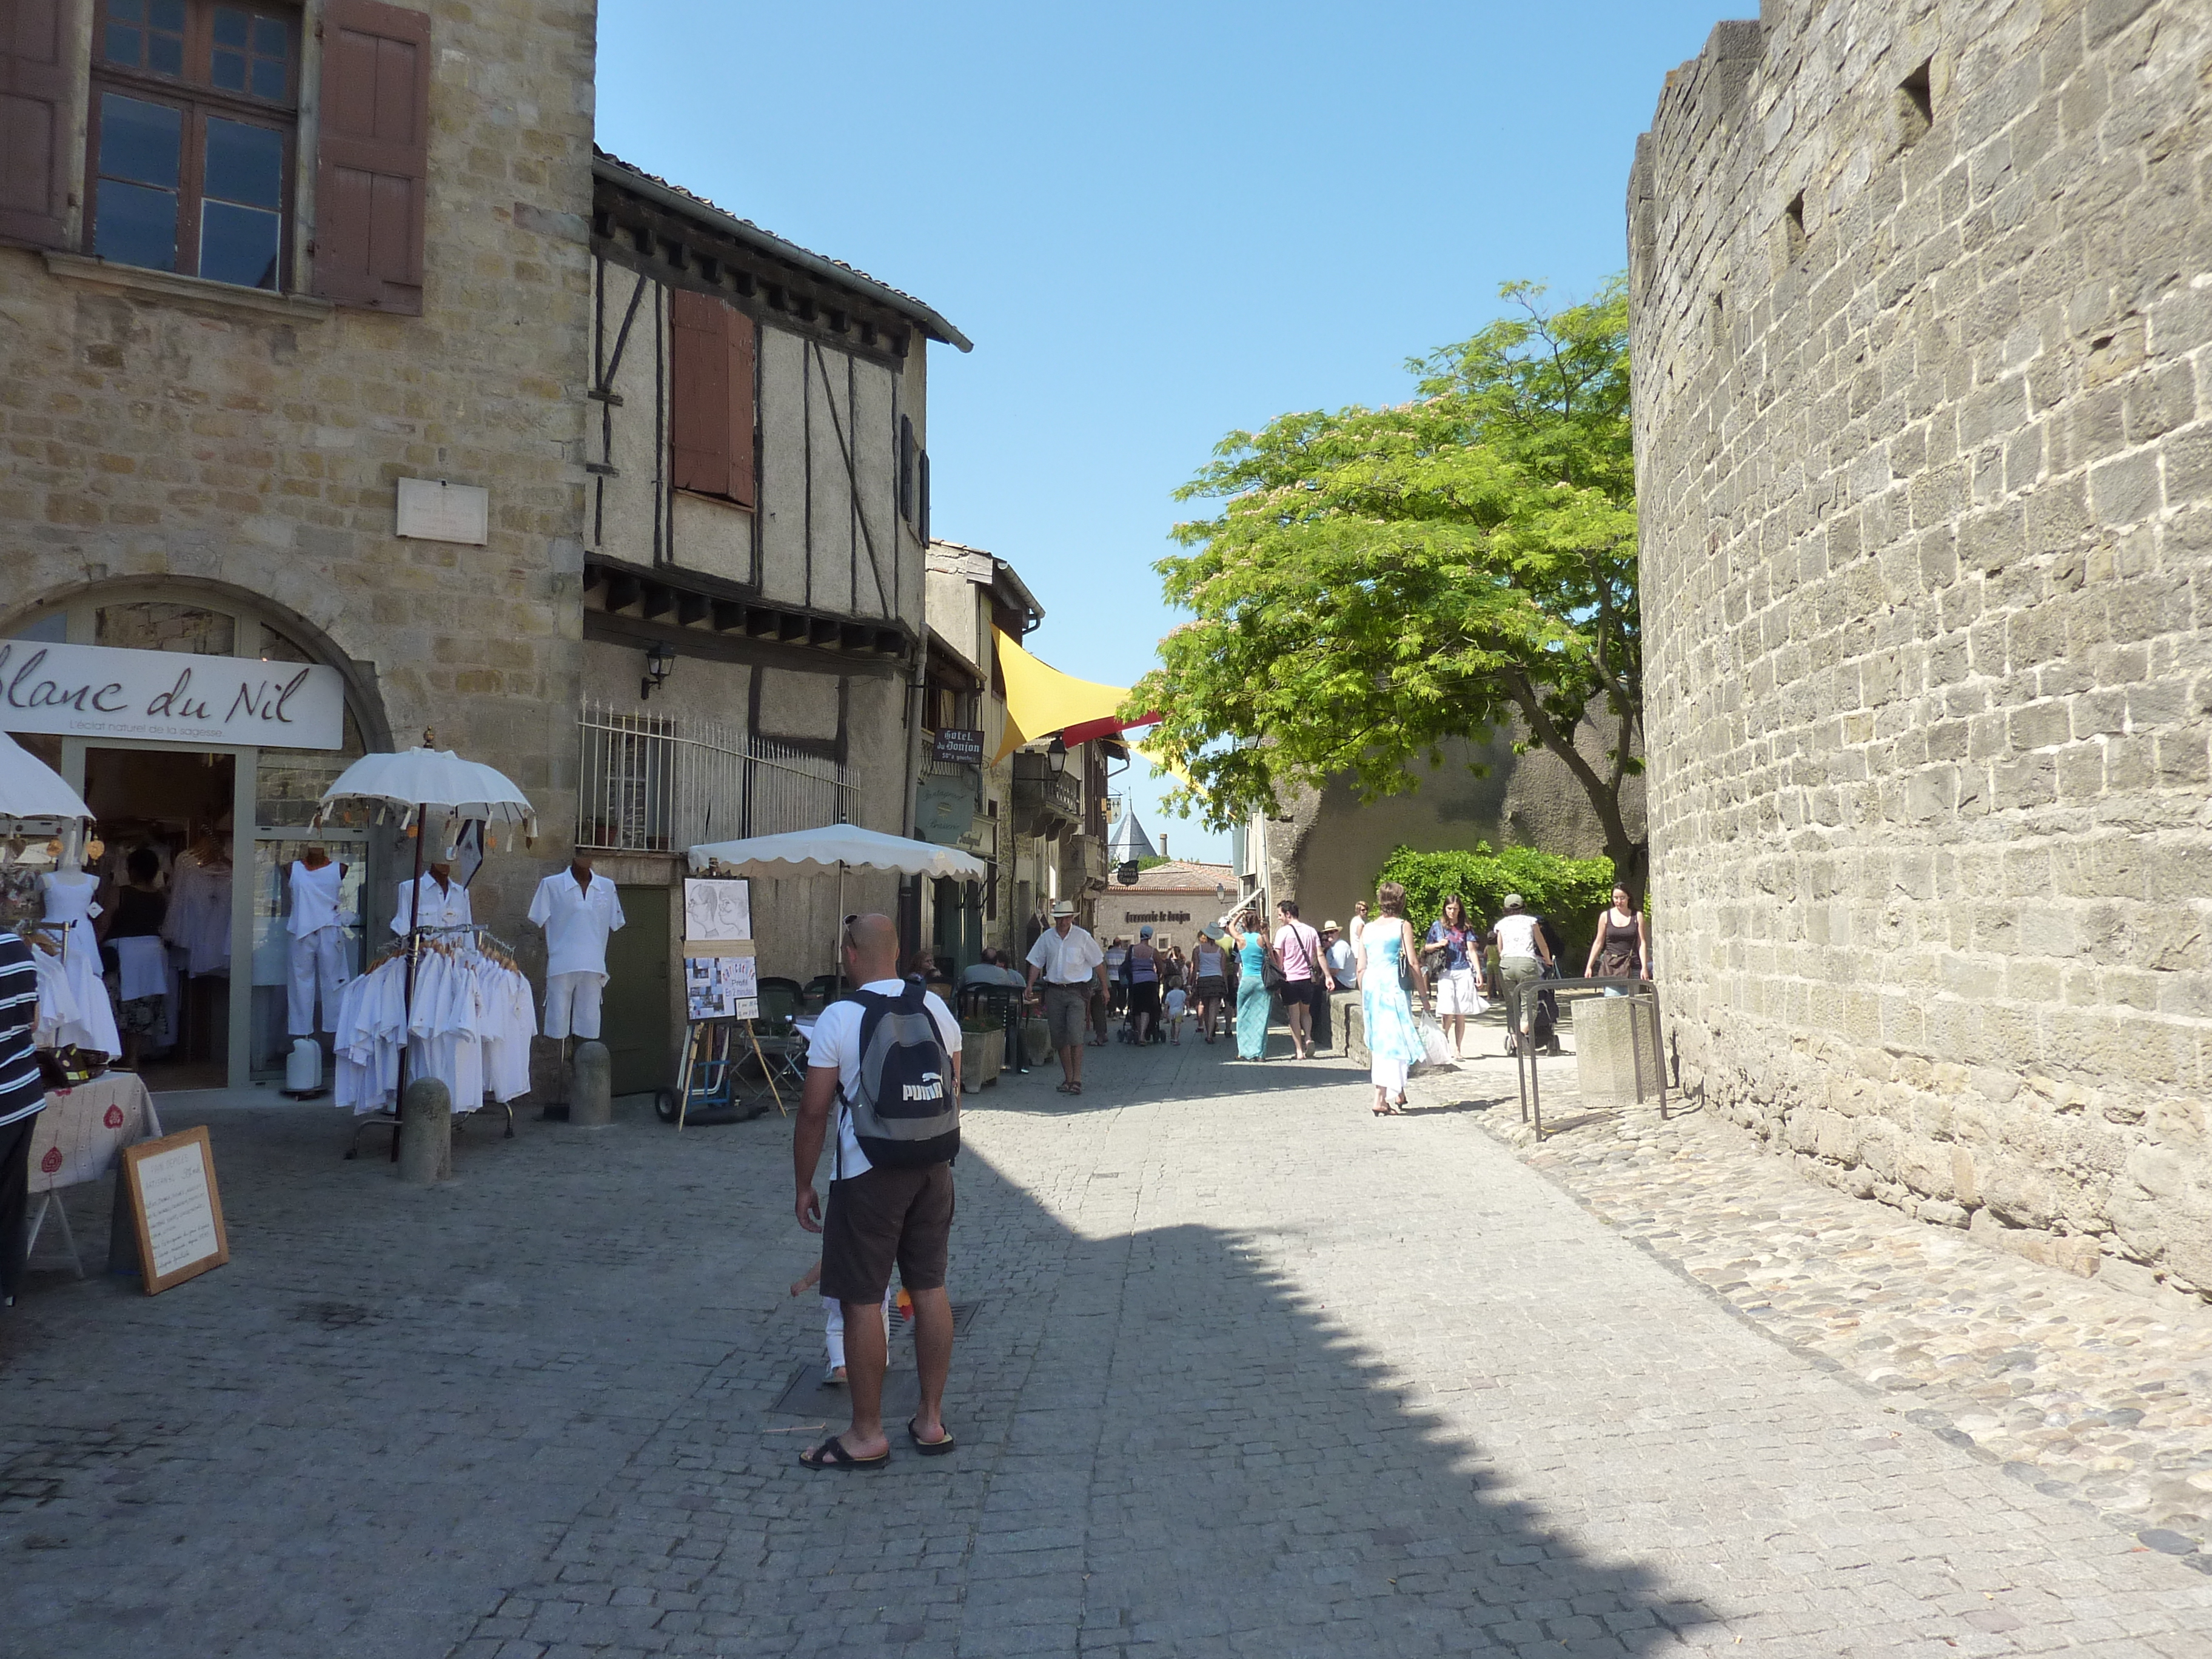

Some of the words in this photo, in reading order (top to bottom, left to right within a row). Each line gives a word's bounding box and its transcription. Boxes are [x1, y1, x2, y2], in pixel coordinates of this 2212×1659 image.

[147, 667, 210, 719] du
[224, 668, 310, 723] Nil
[108, 723, 146, 733] naturel
[937, 742, 945, 750] du
[947, 741, 980, 754] Donjon
[725, 988, 732, 997] En
[732, 988, 736, 996] 2
[903, 1082, 943, 1101] PUMA
